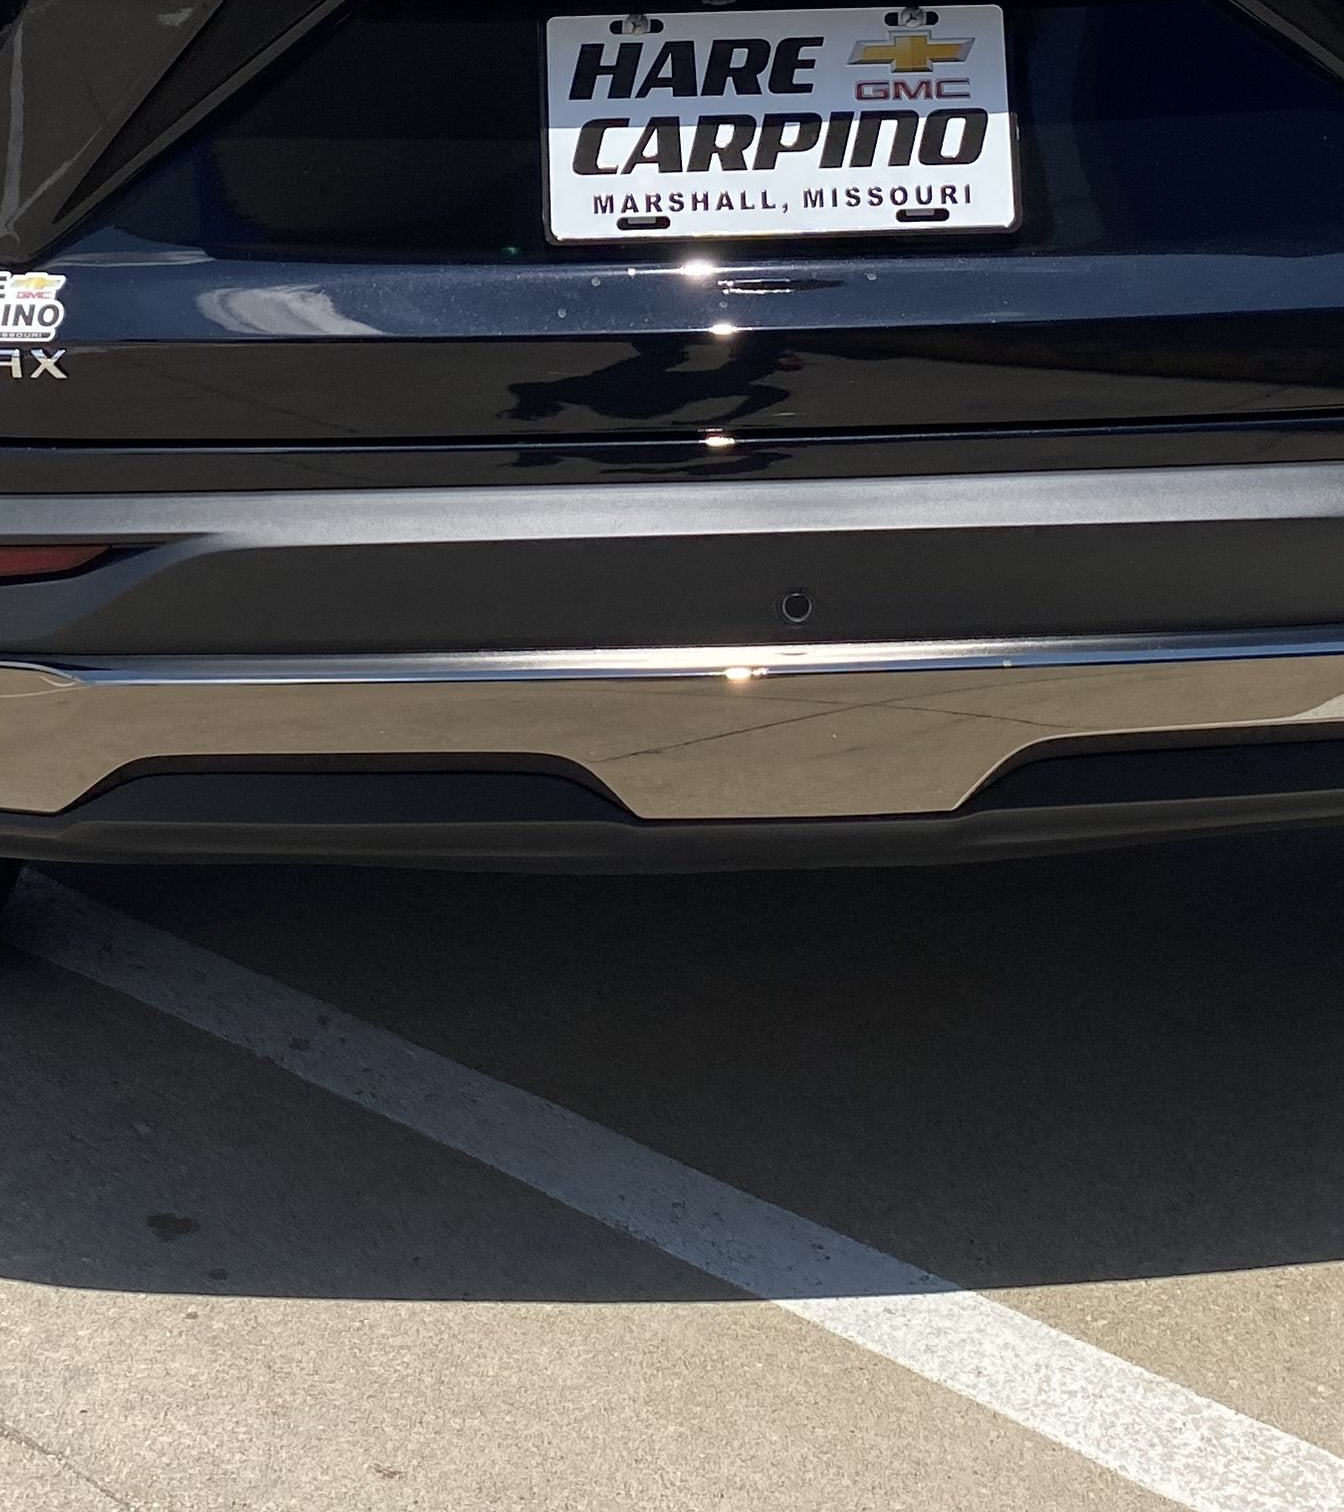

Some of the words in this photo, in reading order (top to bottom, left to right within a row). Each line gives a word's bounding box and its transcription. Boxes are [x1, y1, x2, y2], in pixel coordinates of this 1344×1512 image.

[568, 36, 825, 100] HARE
[855, 78, 971, 101] GMC
[572, 108, 989, 175] CARPINO
[593, 190, 789, 215] MARSHALL,
[802, 184, 973, 209] MISSOURI
